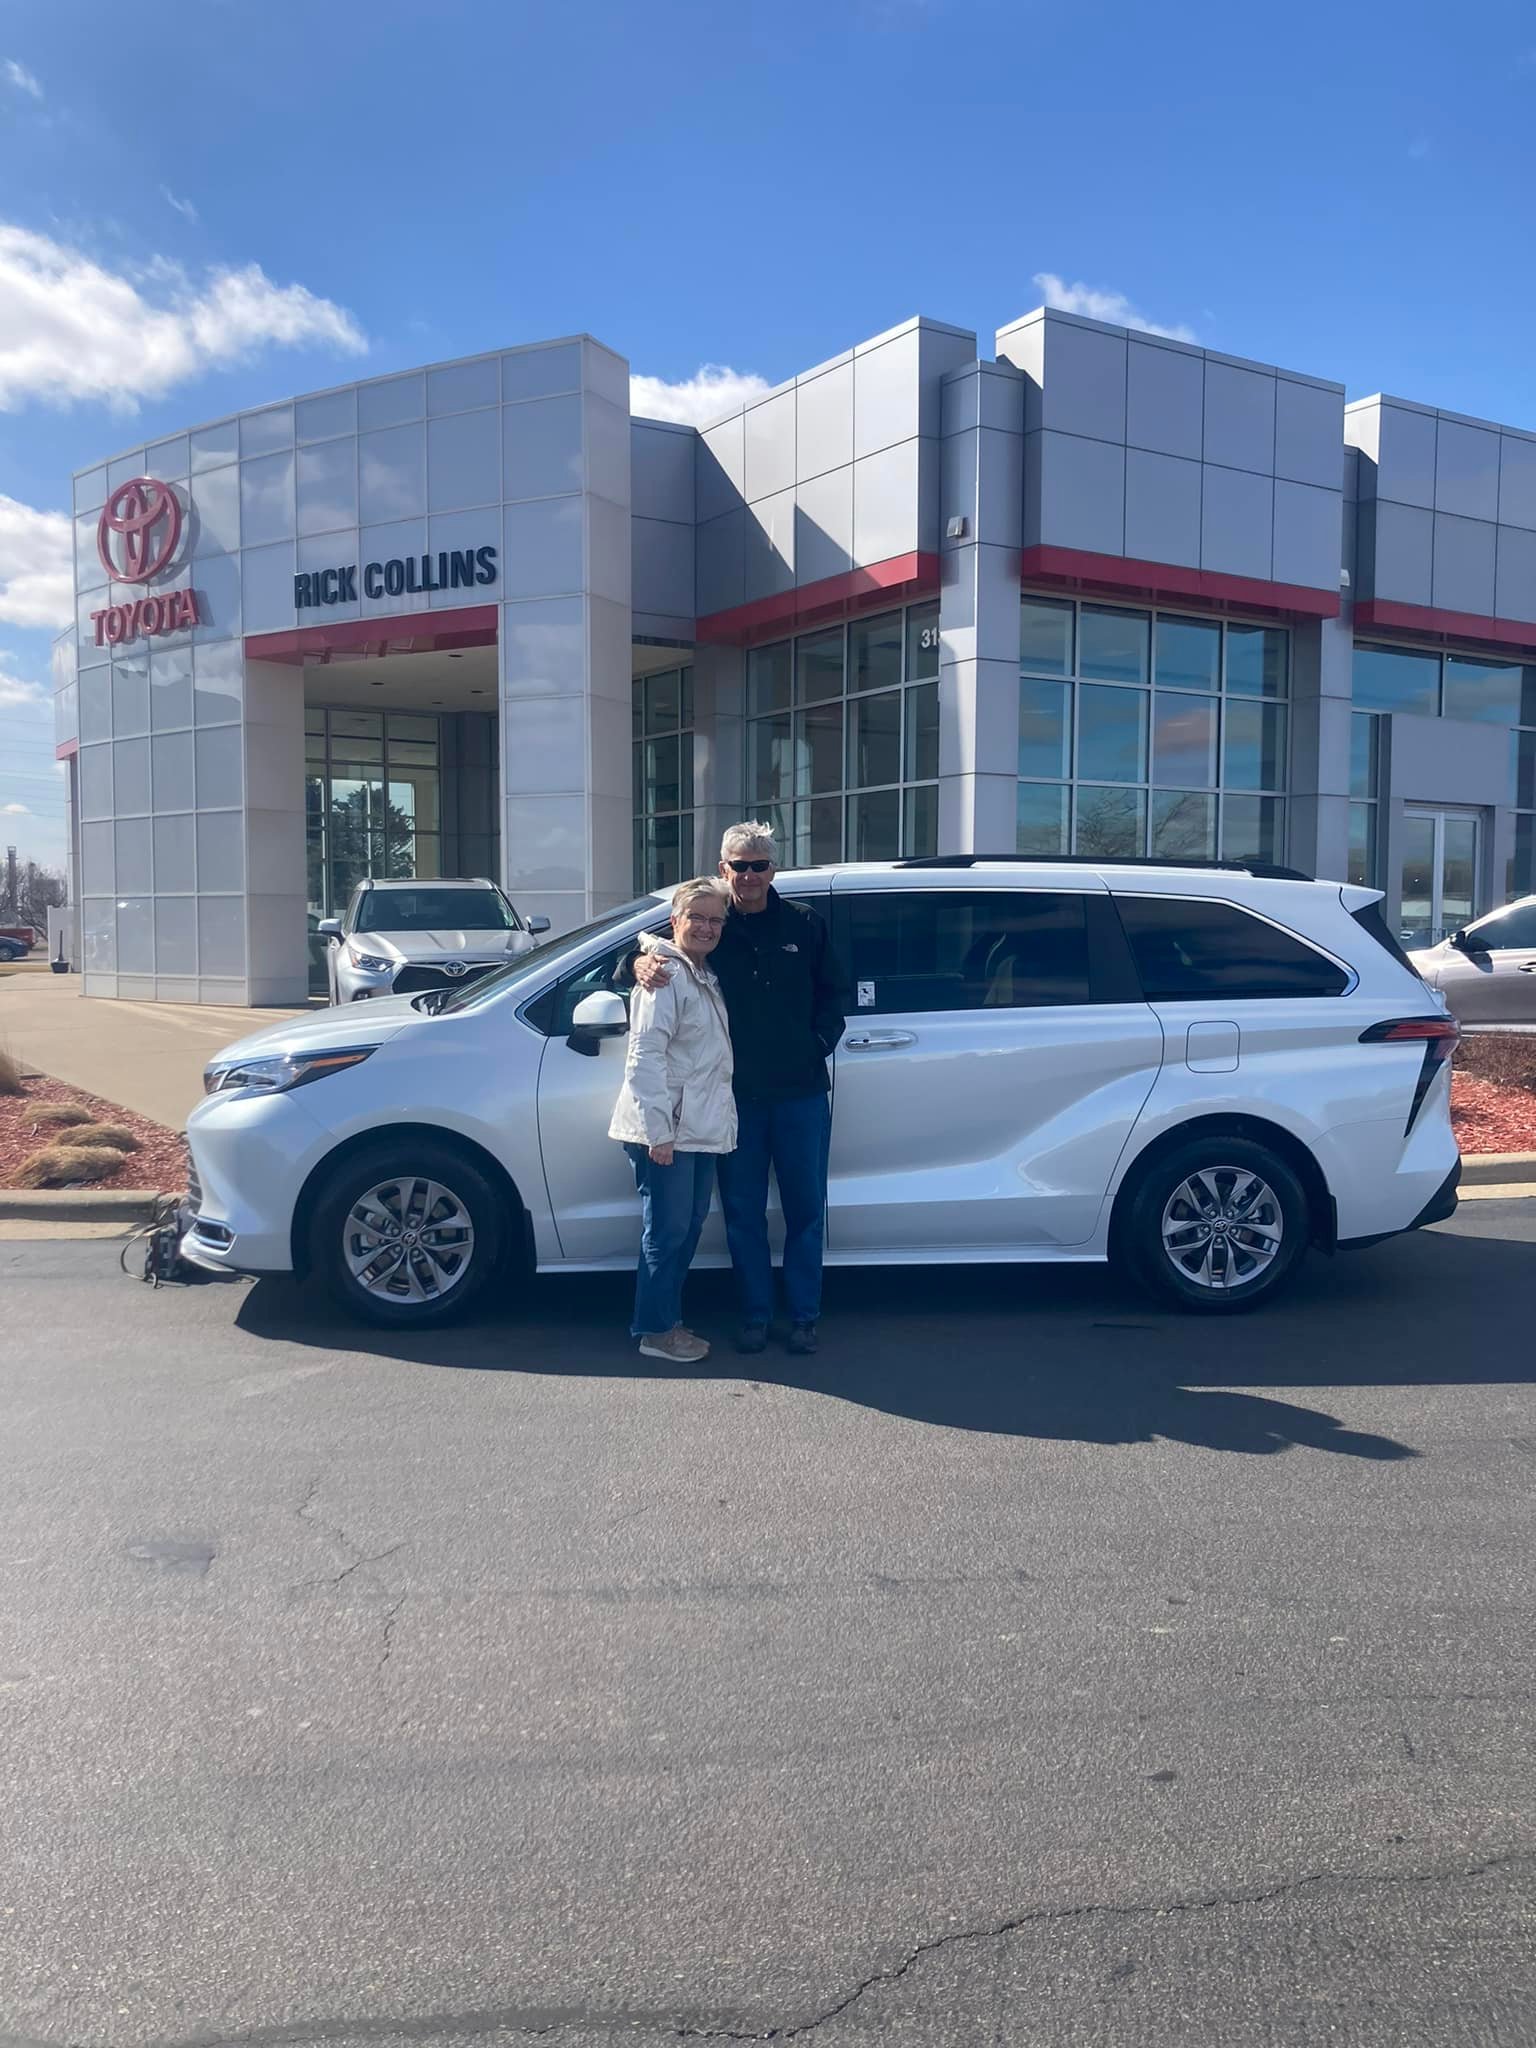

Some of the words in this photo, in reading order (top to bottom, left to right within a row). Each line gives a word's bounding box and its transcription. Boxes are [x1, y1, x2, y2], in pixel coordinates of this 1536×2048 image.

[294, 564, 357, 609] RICK
[364, 545, 497, 600] COLLINS
[90, 587, 199, 647] TOYOTA
[921, 626, 940, 648] 31
